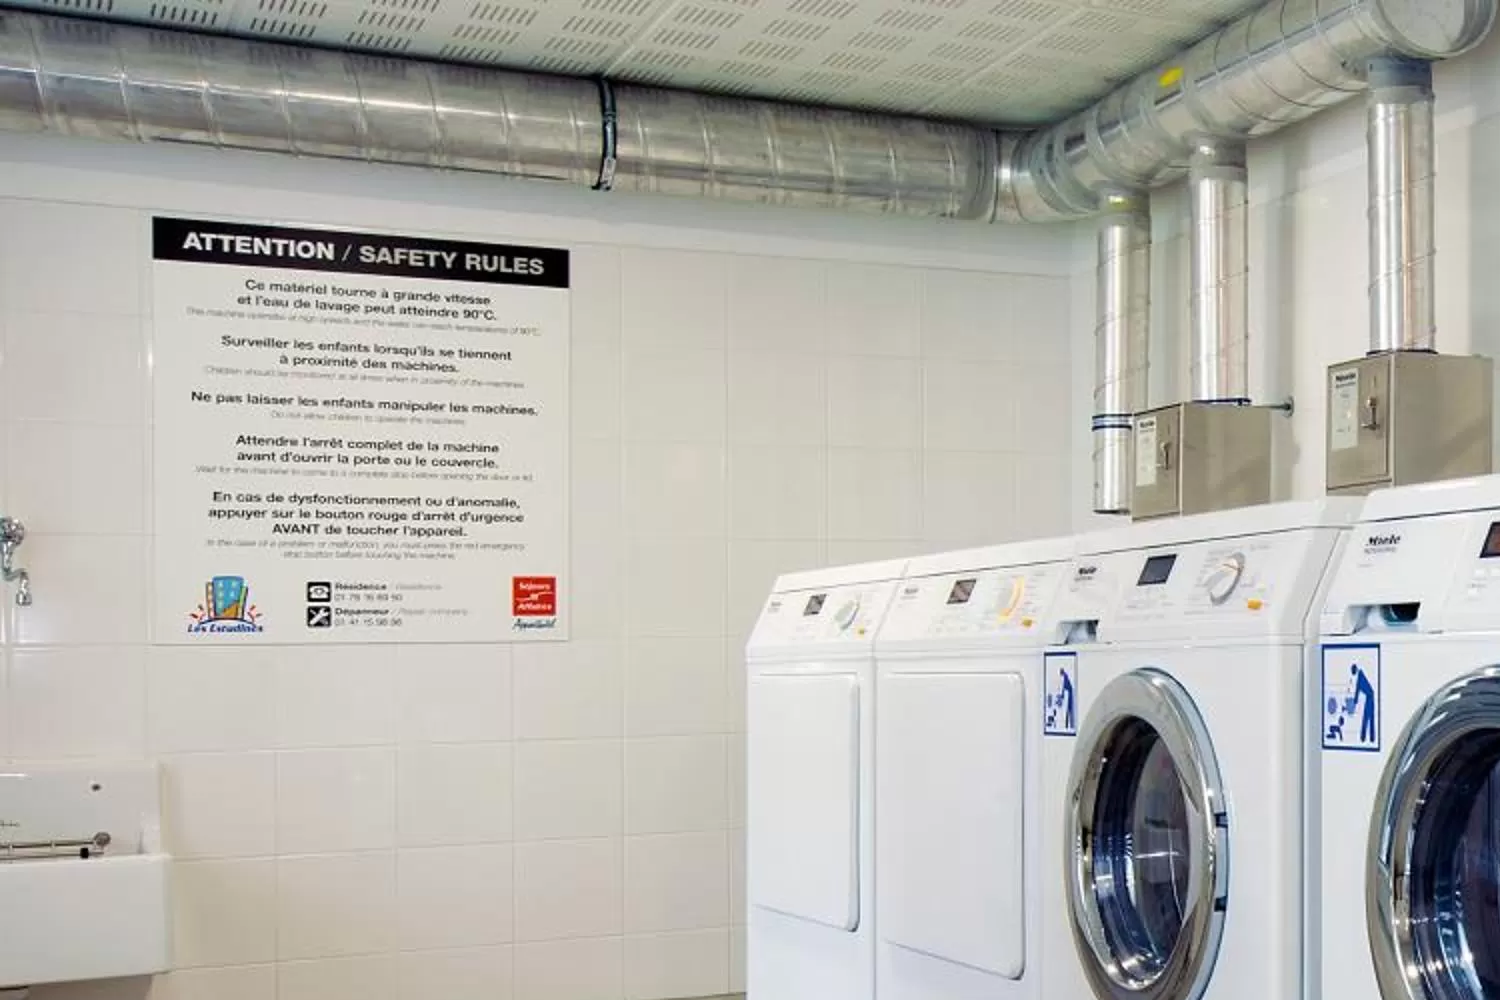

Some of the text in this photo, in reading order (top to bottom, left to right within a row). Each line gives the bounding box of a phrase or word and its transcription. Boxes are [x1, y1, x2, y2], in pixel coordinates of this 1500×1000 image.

[182, 231, 545, 275] ATTENTION / SAFETY RULES
[245, 279, 265, 291] Ce
[331, 285, 377, 298] tourne
[381, 288, 389, 299] à
[393, 291, 441, 302] grande
[444, 292, 490, 305] vitesse
[237, 295, 252, 305] et
[255, 295, 289, 307] l'eau
[293, 298, 311, 309] de
[315, 300, 359, 314] lavage
[364, 304, 395, 316] peut
[400, 305, 458, 318] atteindre
[221, 335, 512, 361] Surveiller les enfants lorsqu'ils se tiennent
[279, 354, 459, 373] à proximité des machines.
[191, 391, 212, 402] Ne
[216, 393, 242, 405] pas
[247, 393, 295, 405] laisser
[298, 396, 319, 407] les
[322, 397, 374, 409] enfants
[380, 400, 446, 413] manipuler
[449, 402, 468, 413] les
[472, 404, 538, 417] machines.
[236, 435, 500, 453] Attendre l'arrêt complet de la machine
[237, 451, 277, 461] avant
[280, 451, 333, 463] d'ouvrir
[337, 453, 349, 464] la
[353, 455, 391, 467] porte
[415, 456, 427, 465] le
[431, 457, 499, 468] couvercle.
[212, 491, 520, 509] En cas de dysfonctionnement ou d'anomalie,
[207, 508, 524, 524] appuyer sur le bouton rouge d'arrêt d'urgence
[271, 523, 468, 537] AVANT de toucher l'appareil.
